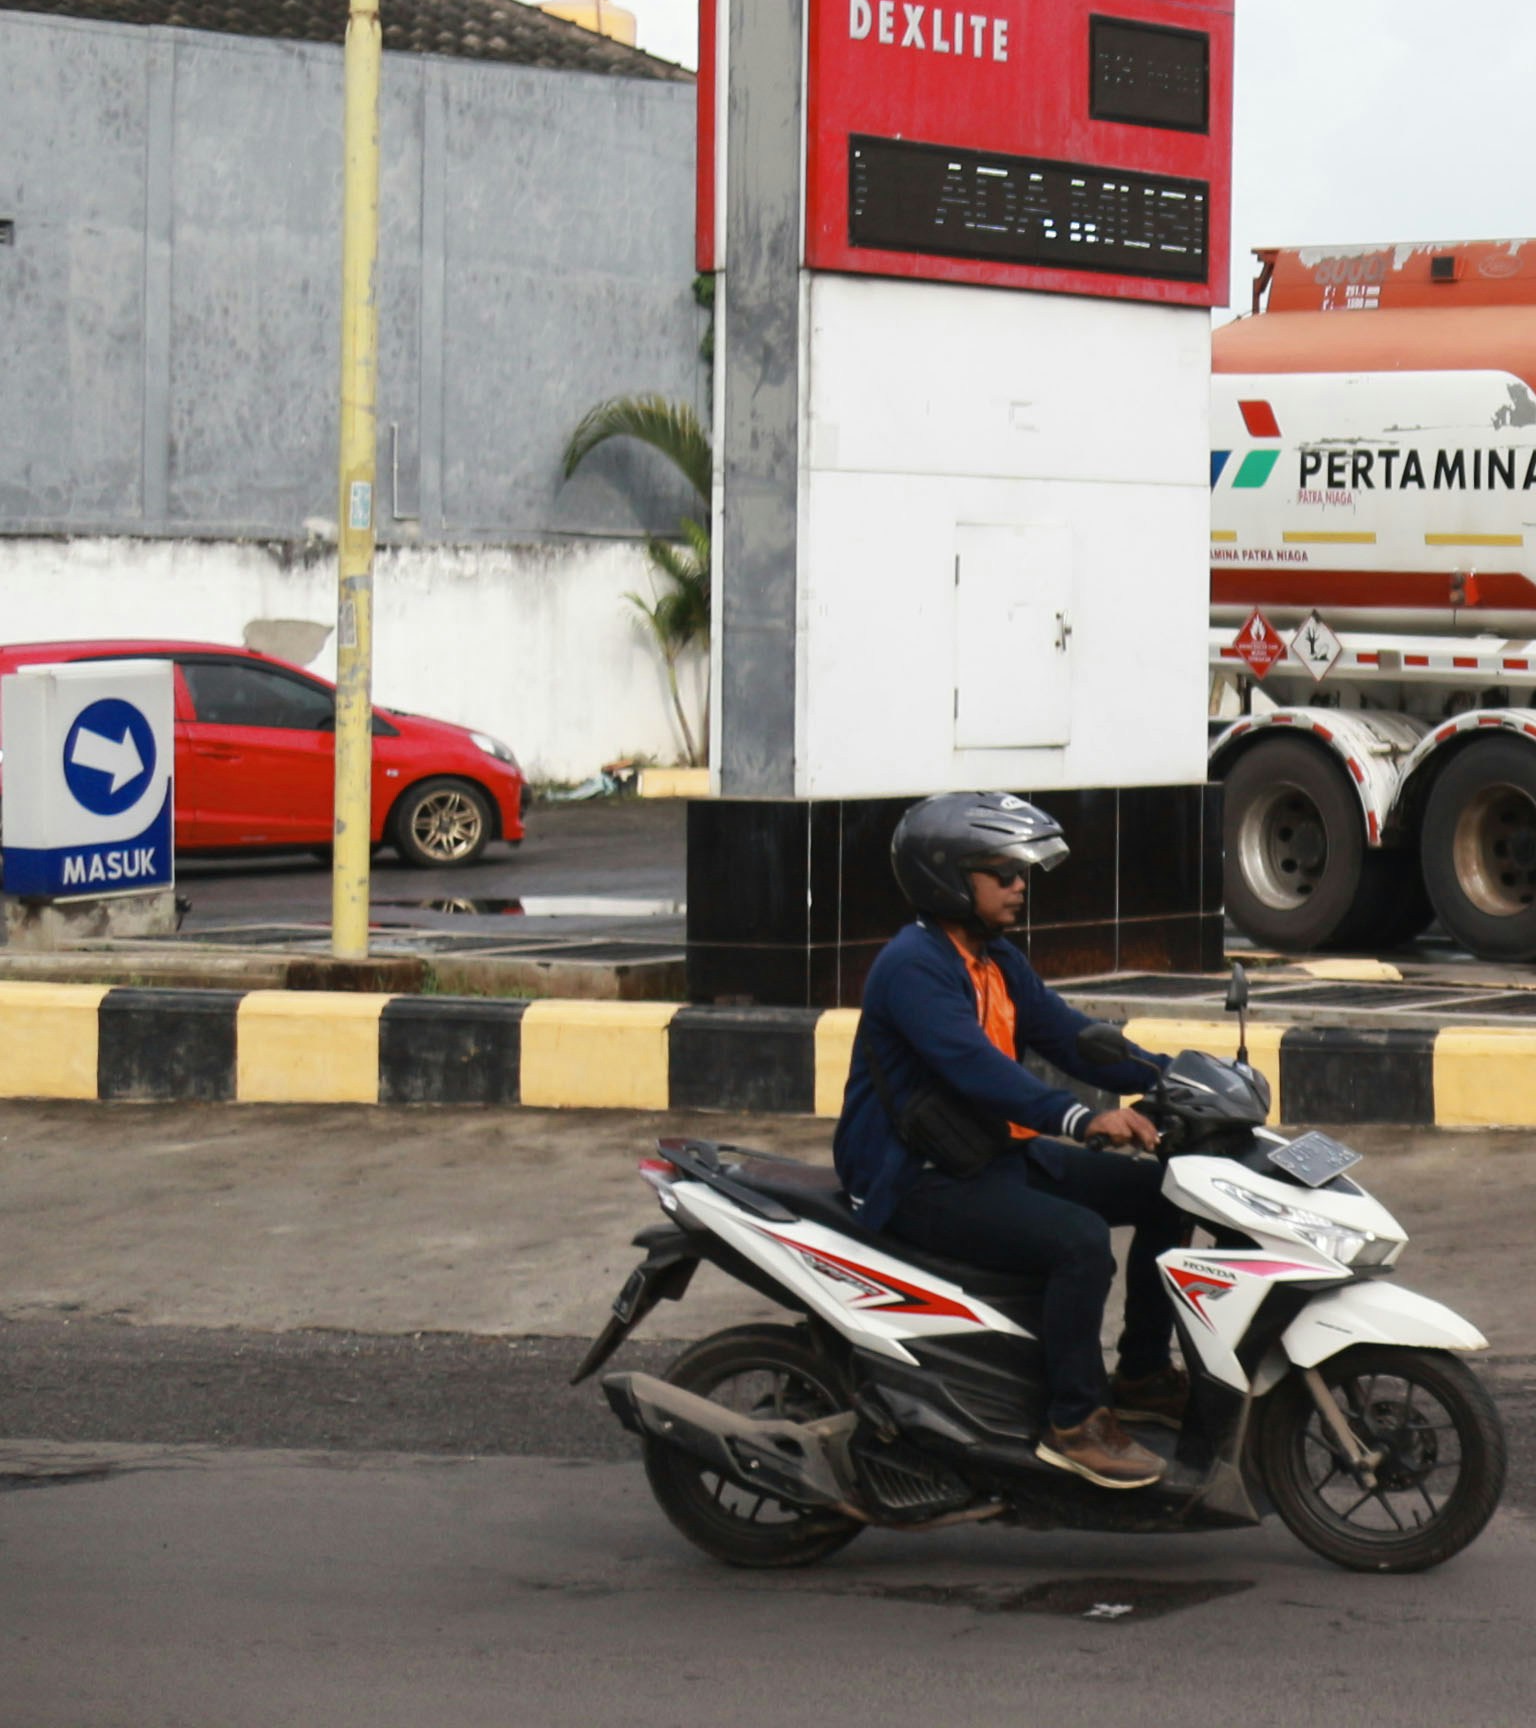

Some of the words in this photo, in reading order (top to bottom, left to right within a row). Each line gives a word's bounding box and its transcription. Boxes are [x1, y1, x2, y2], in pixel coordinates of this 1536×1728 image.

[1242, 549, 1274, 561] PATRA
[1277, 550, 1309, 562] NIAGA
[63, 847, 156, 885] MASUK
[1183, 1259, 1237, 1281] HONDA
